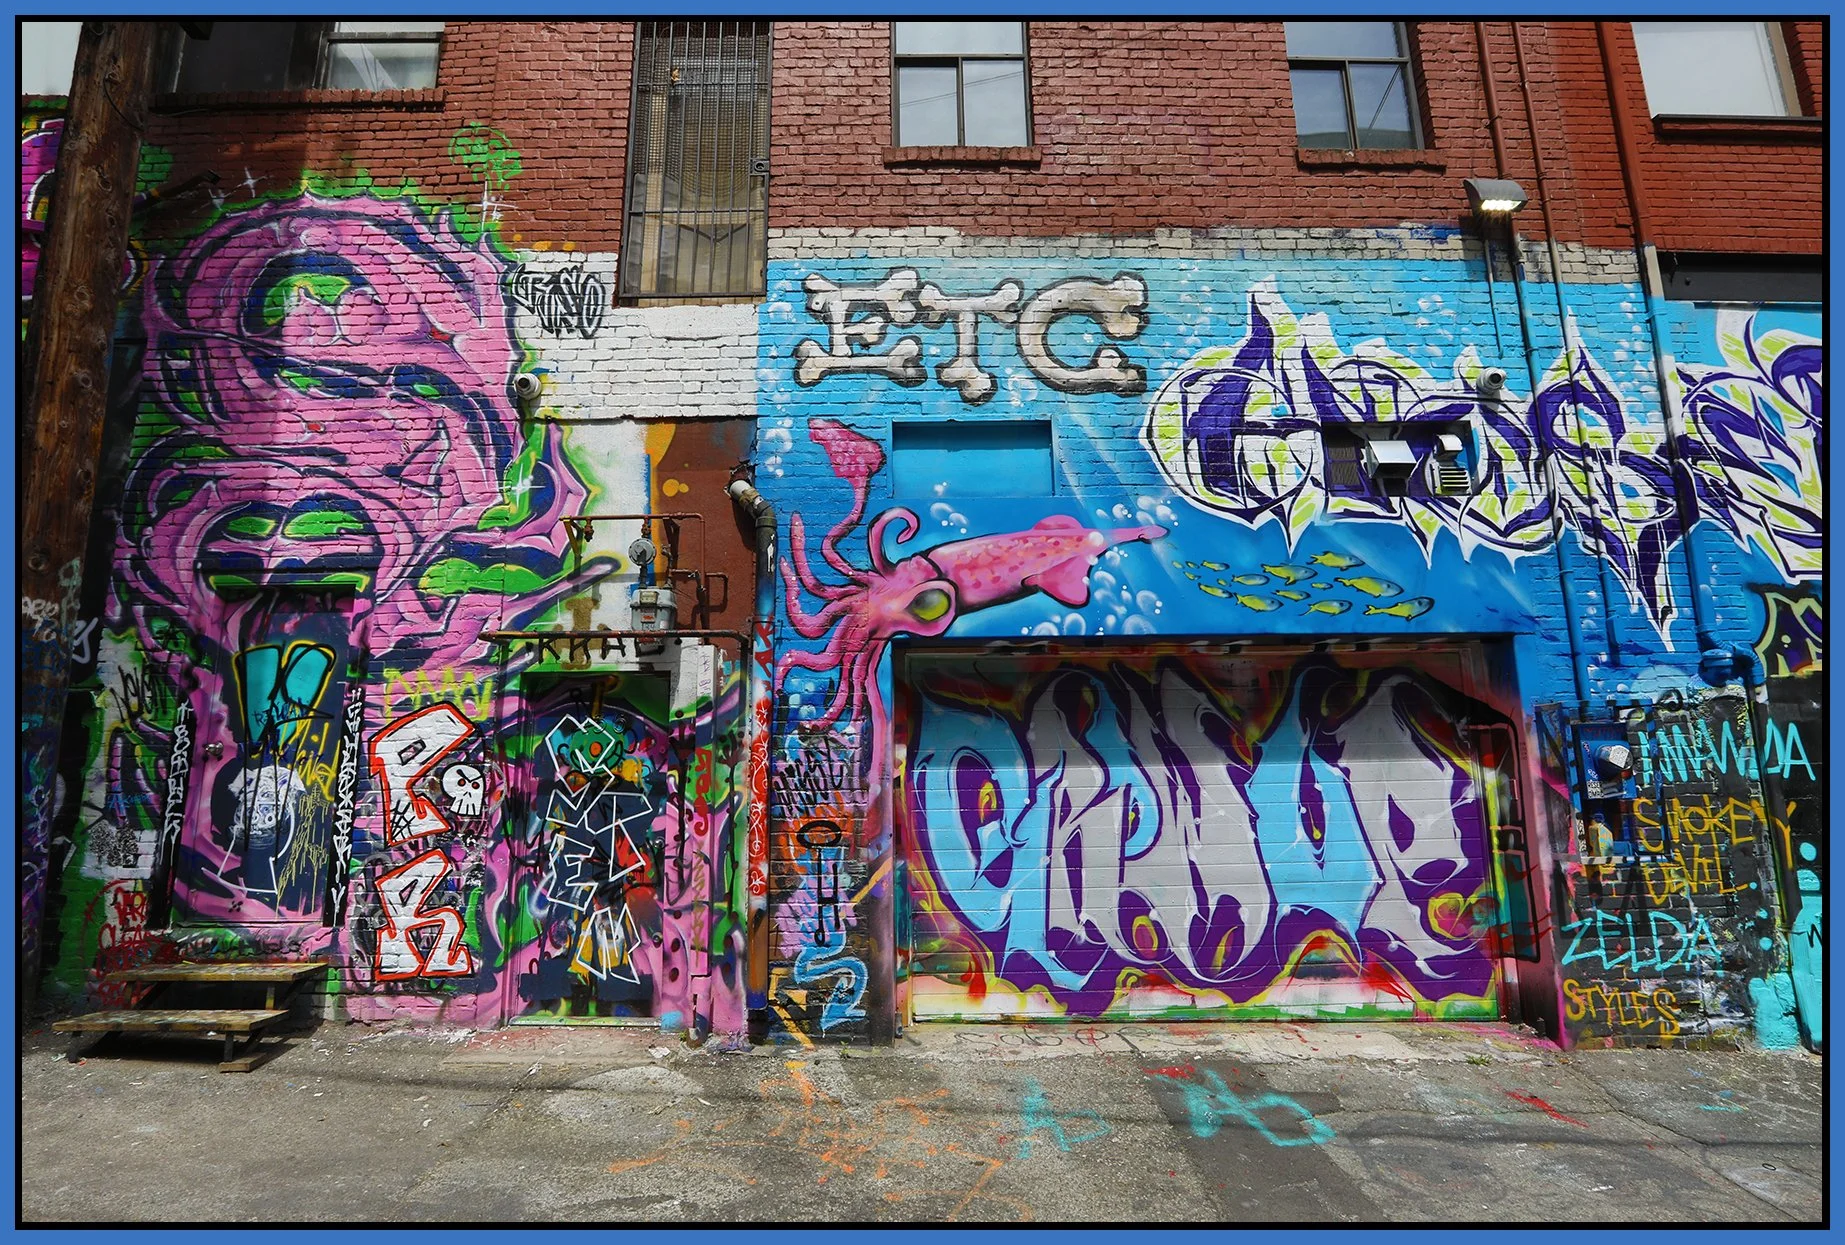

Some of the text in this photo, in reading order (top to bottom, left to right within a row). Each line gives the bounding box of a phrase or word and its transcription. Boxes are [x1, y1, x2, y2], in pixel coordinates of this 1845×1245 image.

[793, 266, 1148, 405] ETC
[1561, 909, 1724, 978] ZELDA
[1563, 978, 1682, 1038] STYLES
